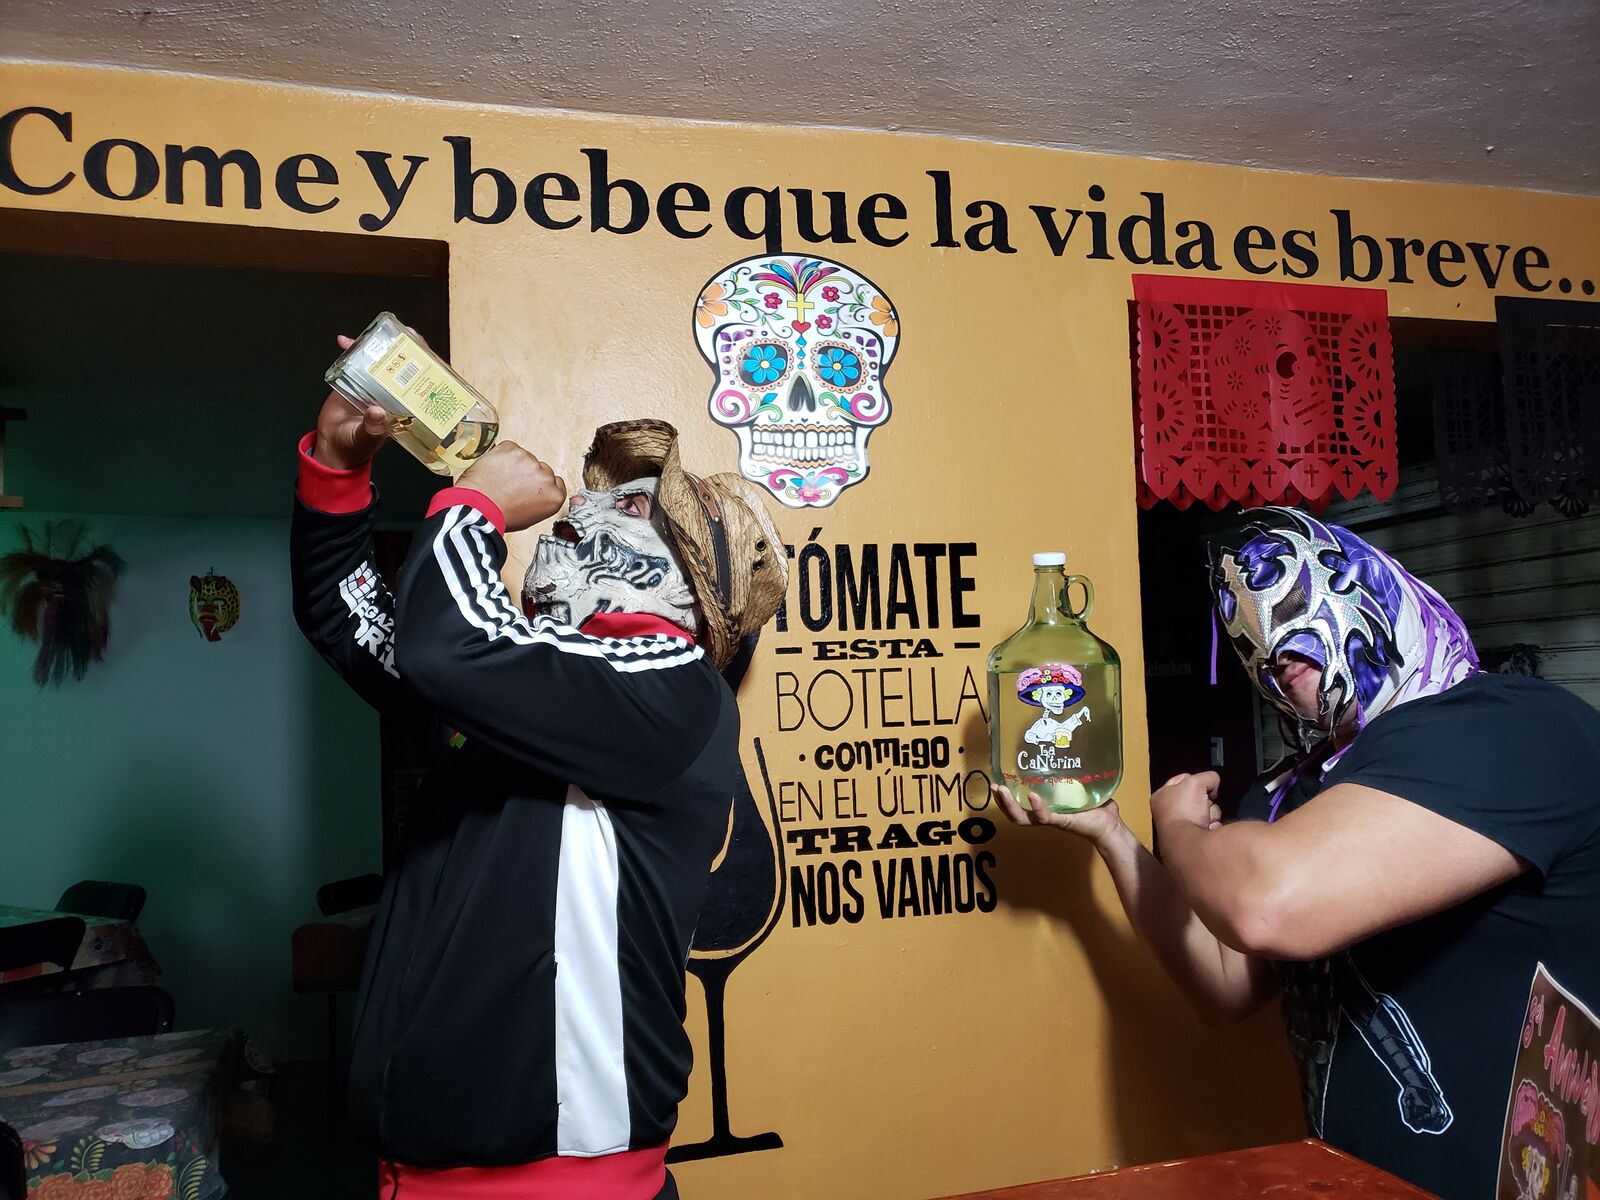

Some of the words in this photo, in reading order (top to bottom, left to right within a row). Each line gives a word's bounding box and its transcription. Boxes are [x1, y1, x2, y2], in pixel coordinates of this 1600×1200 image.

[0, 106, 341, 214] Come
[355, 150, 430, 232] y
[442, 135, 713, 240] bebe
[724, 184, 910, 254] que
[925, 170, 1018, 255] la
[1029, 184, 1223, 272] vida
[1234, 225, 1320, 279] es
[811, 638, 944, 661] ESTA
[1146, 660, 1192, 677] eineken
[775, 665, 989, 732] BOTELLA
[1039, 744, 1056, 756] La
[779, 780, 824, 823] EN
[833, 778, 868, 819] EL
[876, 767, 992, 818] ÚLTIMO
[786, 816, 997, 856] TRAGO
[790, 859, 865, 928] NOS
[872, 850, 998, 920] VAMOS
